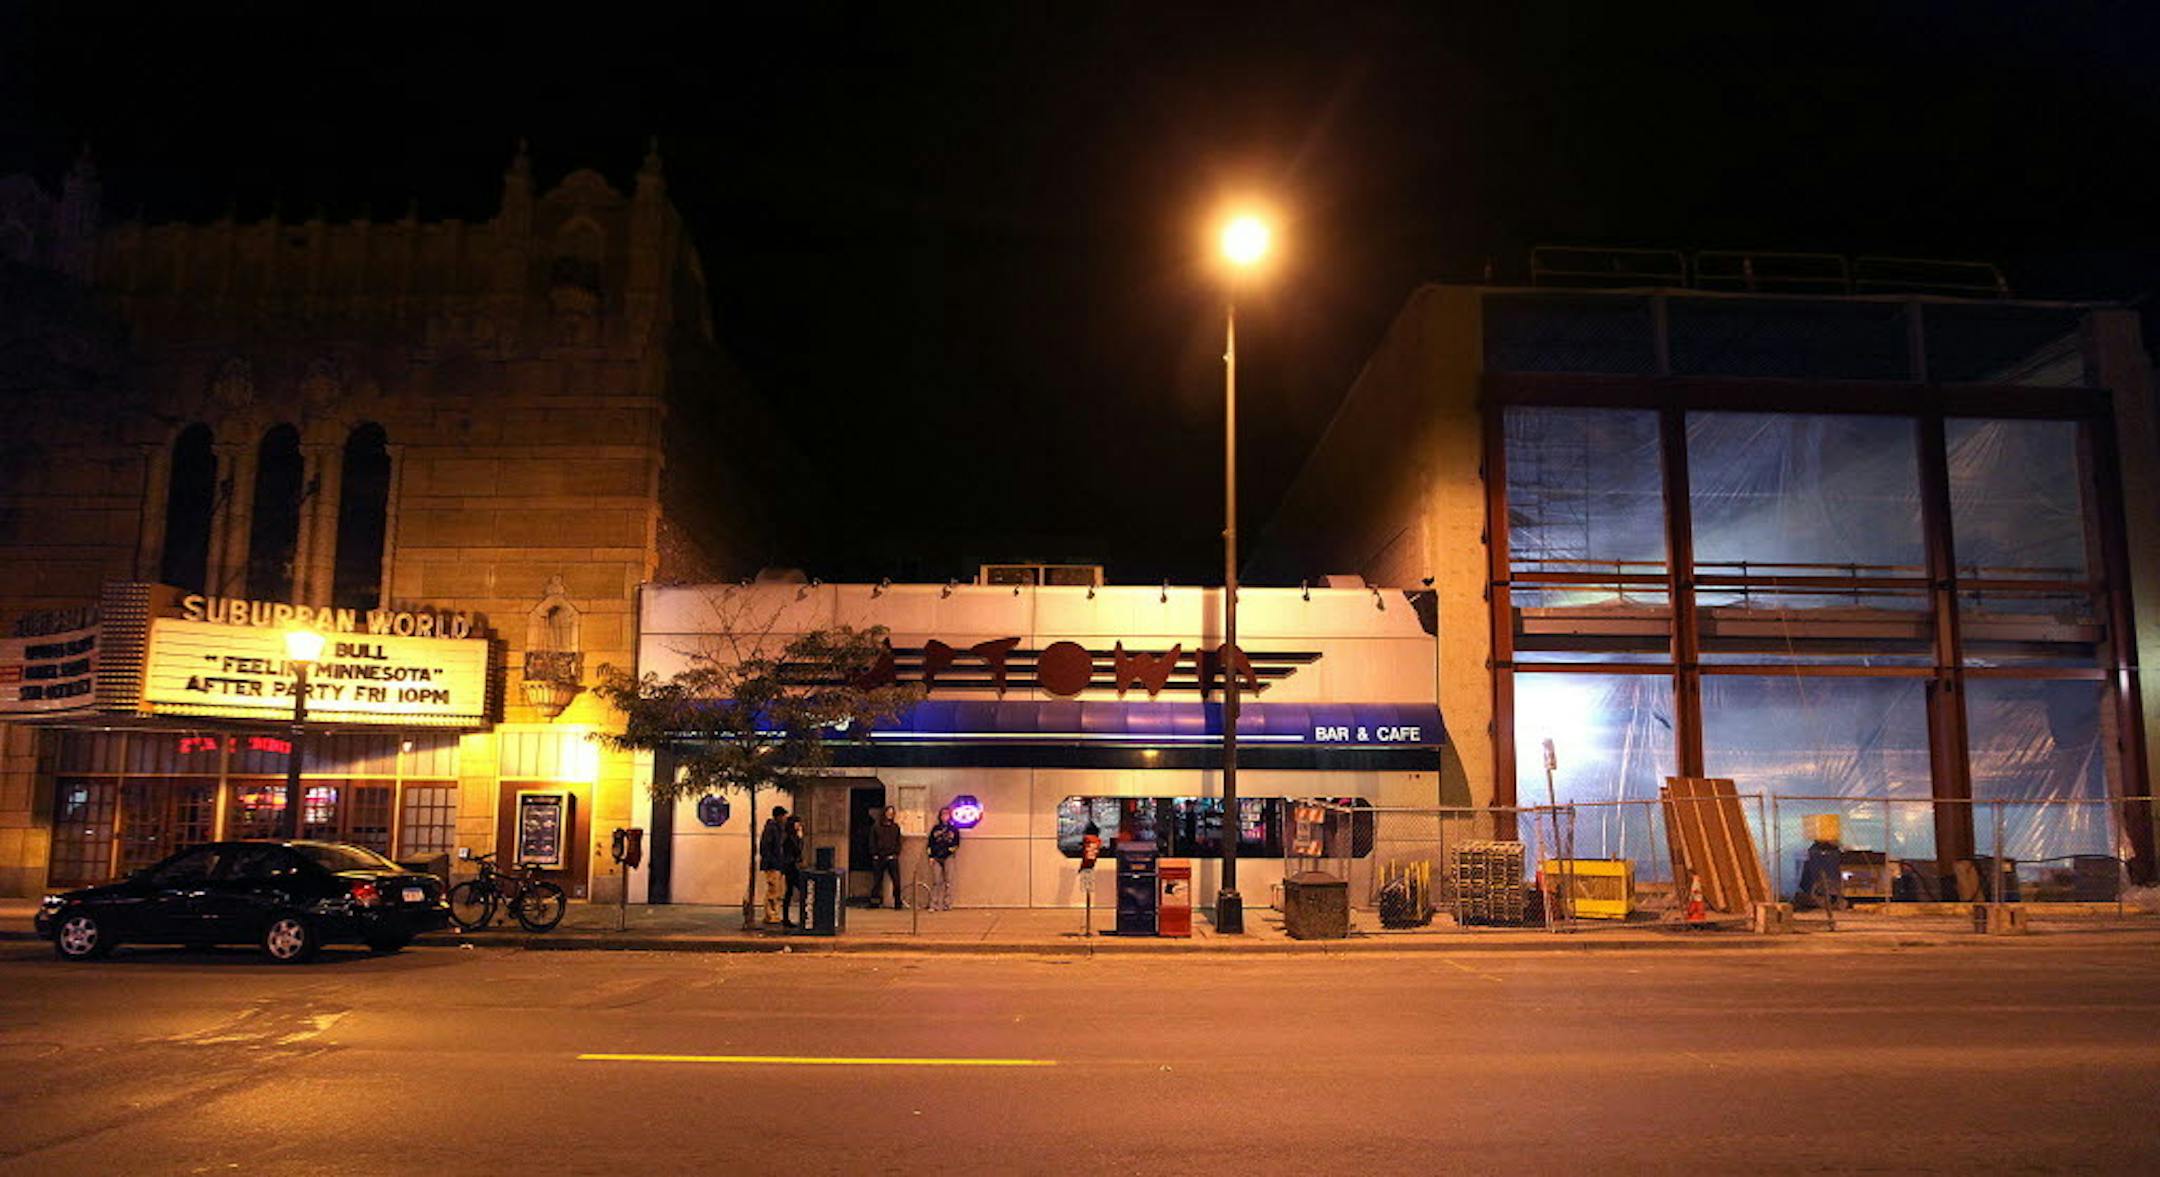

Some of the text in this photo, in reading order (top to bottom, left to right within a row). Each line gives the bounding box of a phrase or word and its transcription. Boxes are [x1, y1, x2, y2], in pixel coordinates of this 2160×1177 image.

[183, 595, 471, 640] SUBURBAN WORLD
[335, 642, 388, 660] BULL
[185, 674, 449, 704] AFTER PARTY FRI 10PM
[1315, 726, 1420, 741] BAR & CAFE
